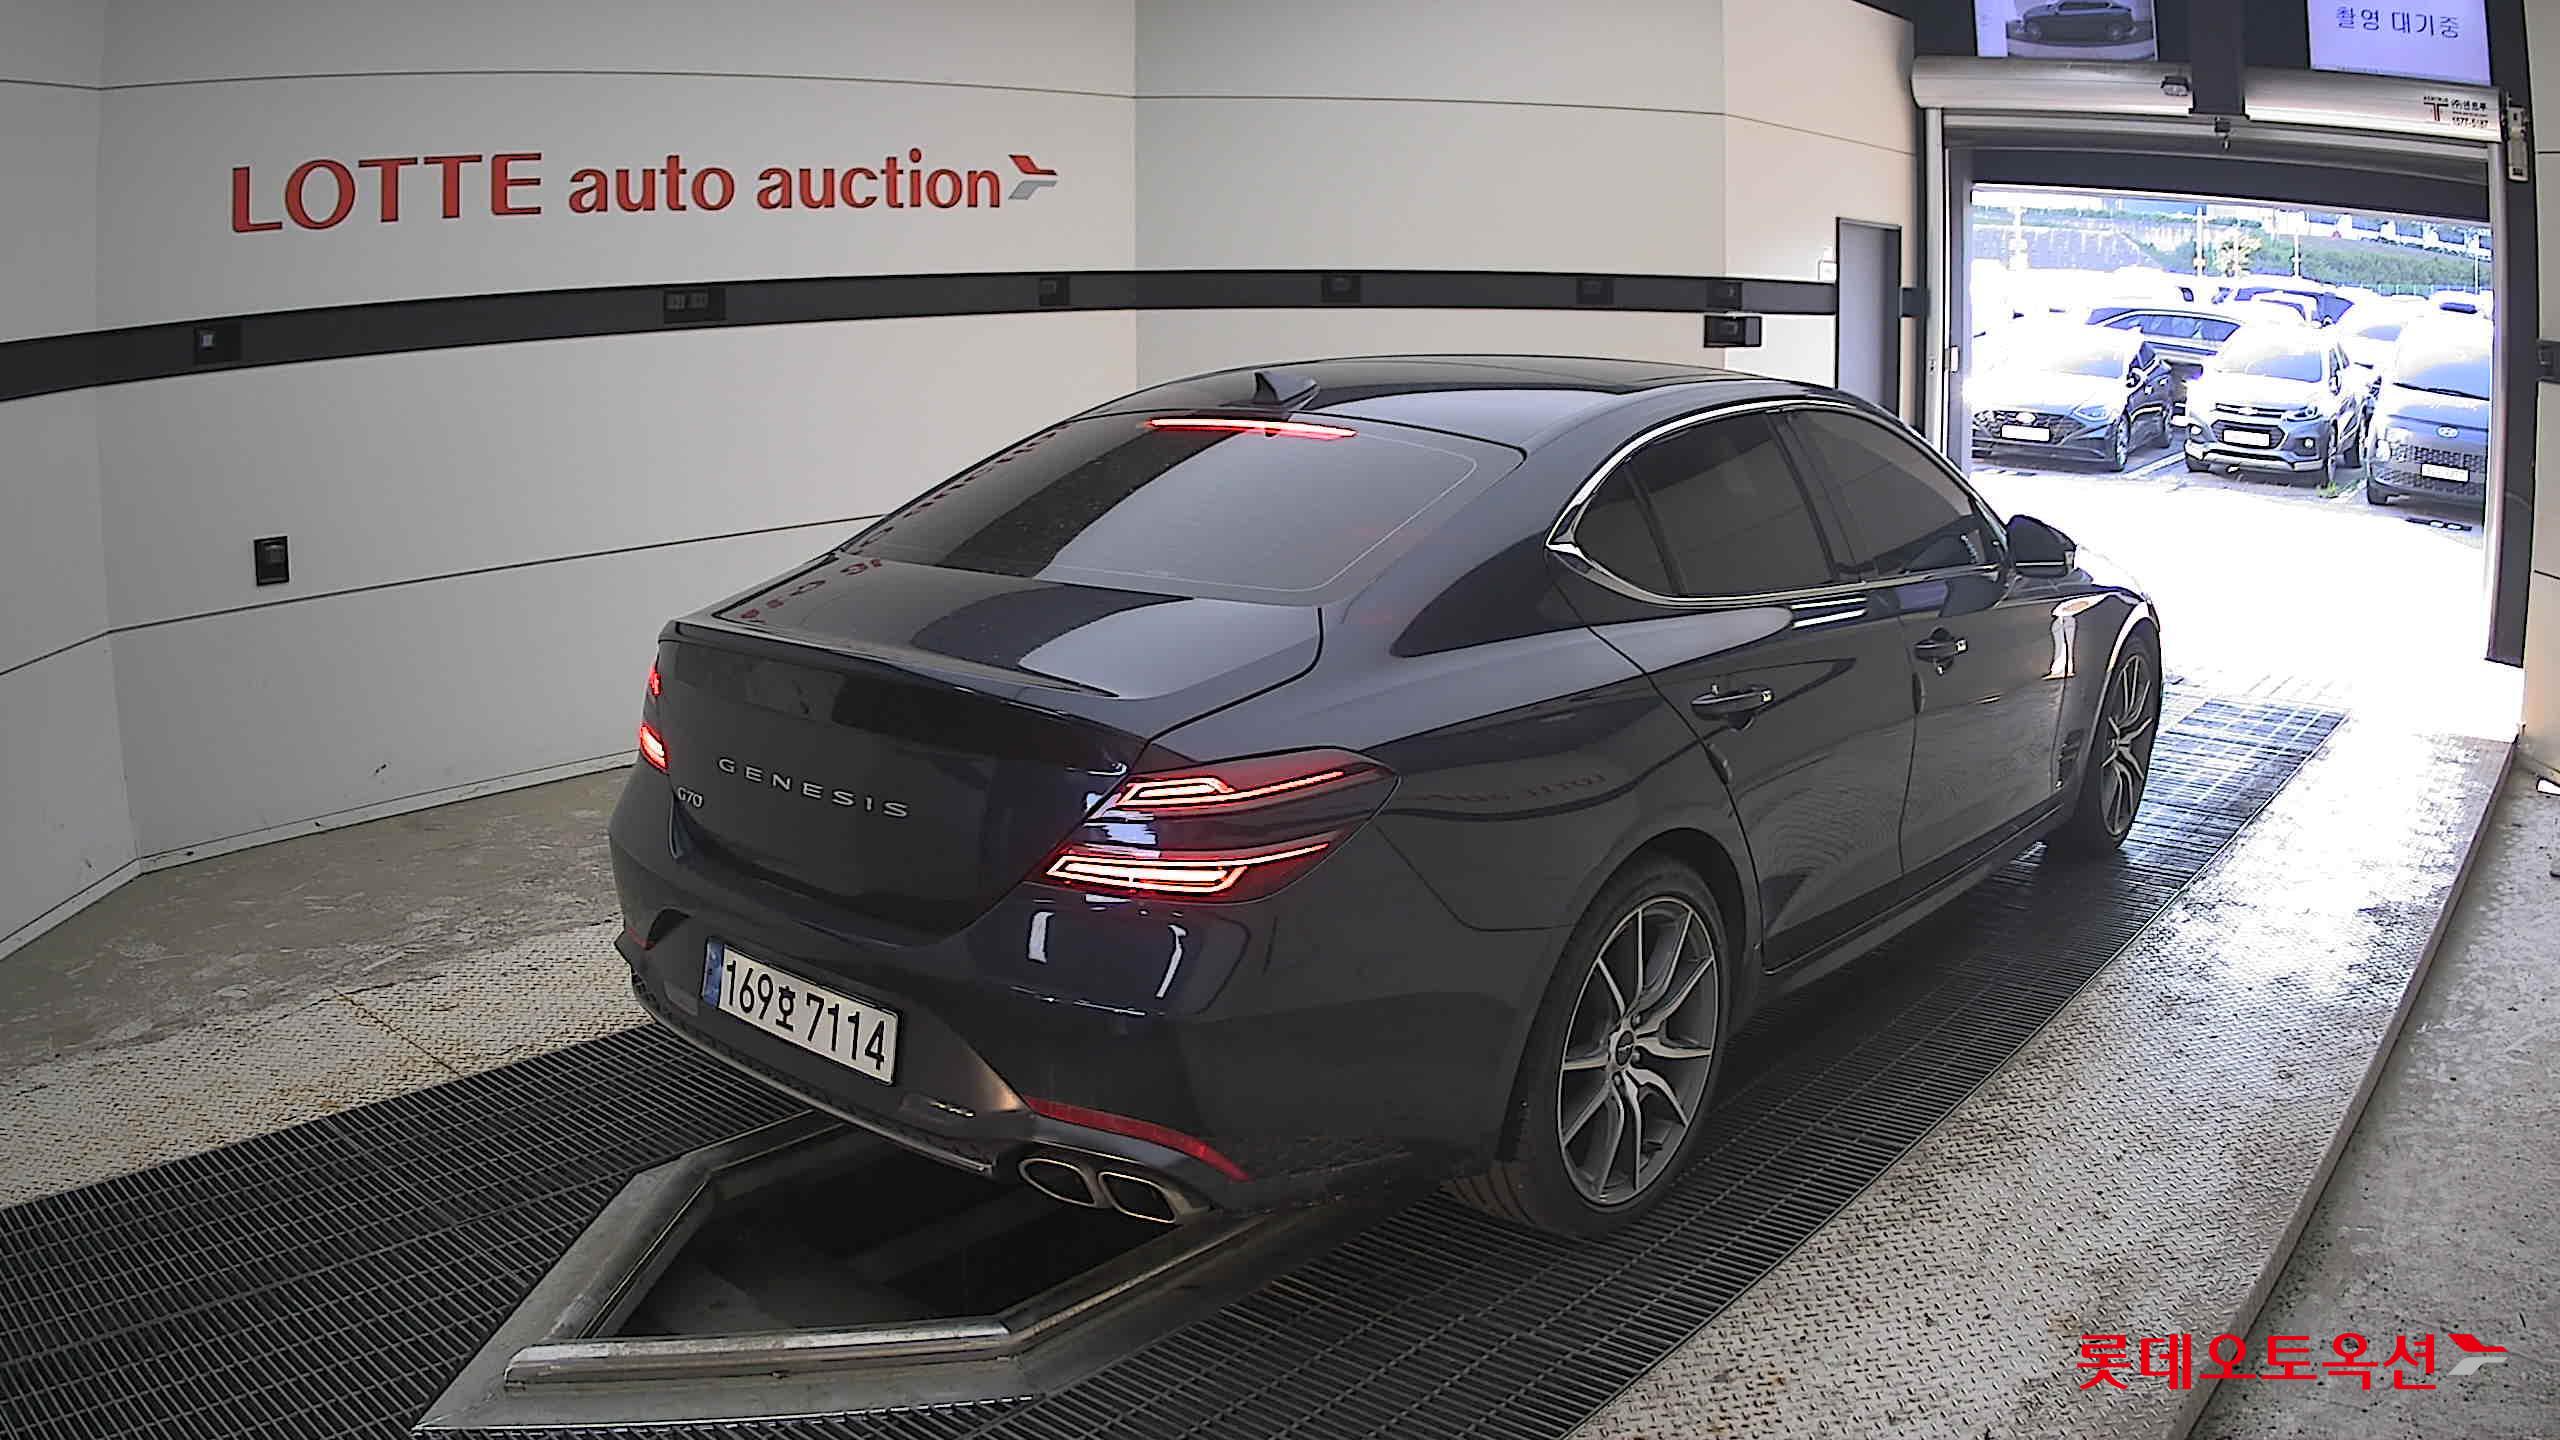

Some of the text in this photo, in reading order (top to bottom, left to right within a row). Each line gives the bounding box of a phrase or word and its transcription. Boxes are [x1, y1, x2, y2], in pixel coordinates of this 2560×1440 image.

[2391, 11, 2459, 39] 대기중
[232, 147, 1001, 233] LOTTE auto auction
[676, 786, 704, 808] G70
[717, 757, 909, 818] GENESIS
